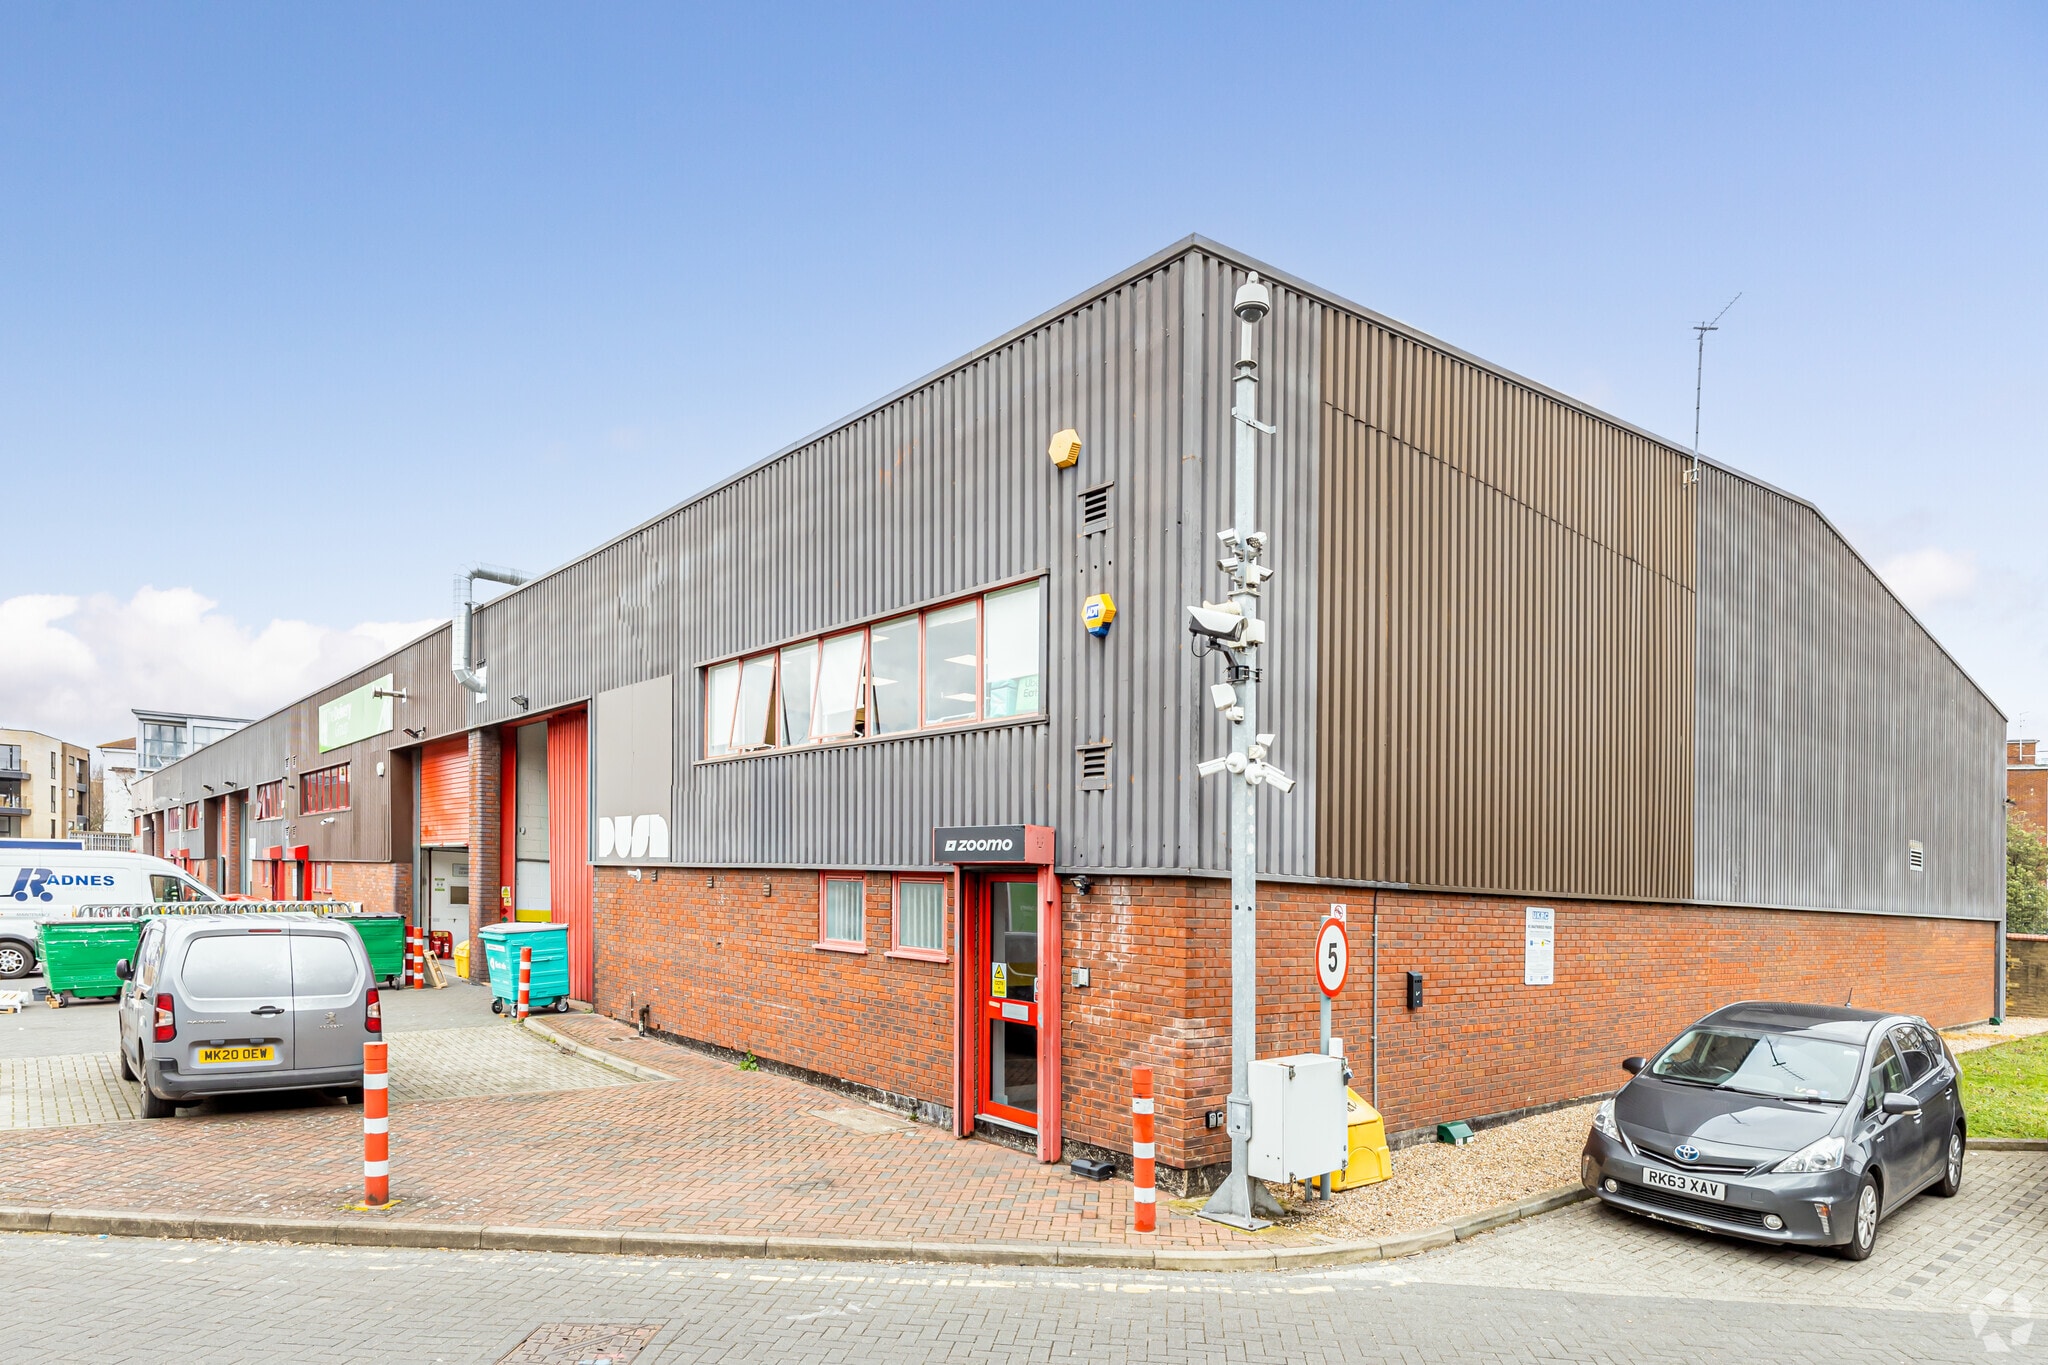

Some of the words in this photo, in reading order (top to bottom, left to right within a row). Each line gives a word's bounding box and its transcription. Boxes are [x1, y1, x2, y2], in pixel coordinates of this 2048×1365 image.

[1025, 680, 1038, 688] Ube
[1023, 689, 1038, 697] Eat
[957, 839, 1013, 851] zoomo
[1328, 942, 1338, 973] 5
[204, 1049, 239, 1061] MK20
[242, 1048, 268, 1059] OEW
[1649, 1170, 1686, 1189] RK63
[1690, 1178, 1718, 1196] XAV
